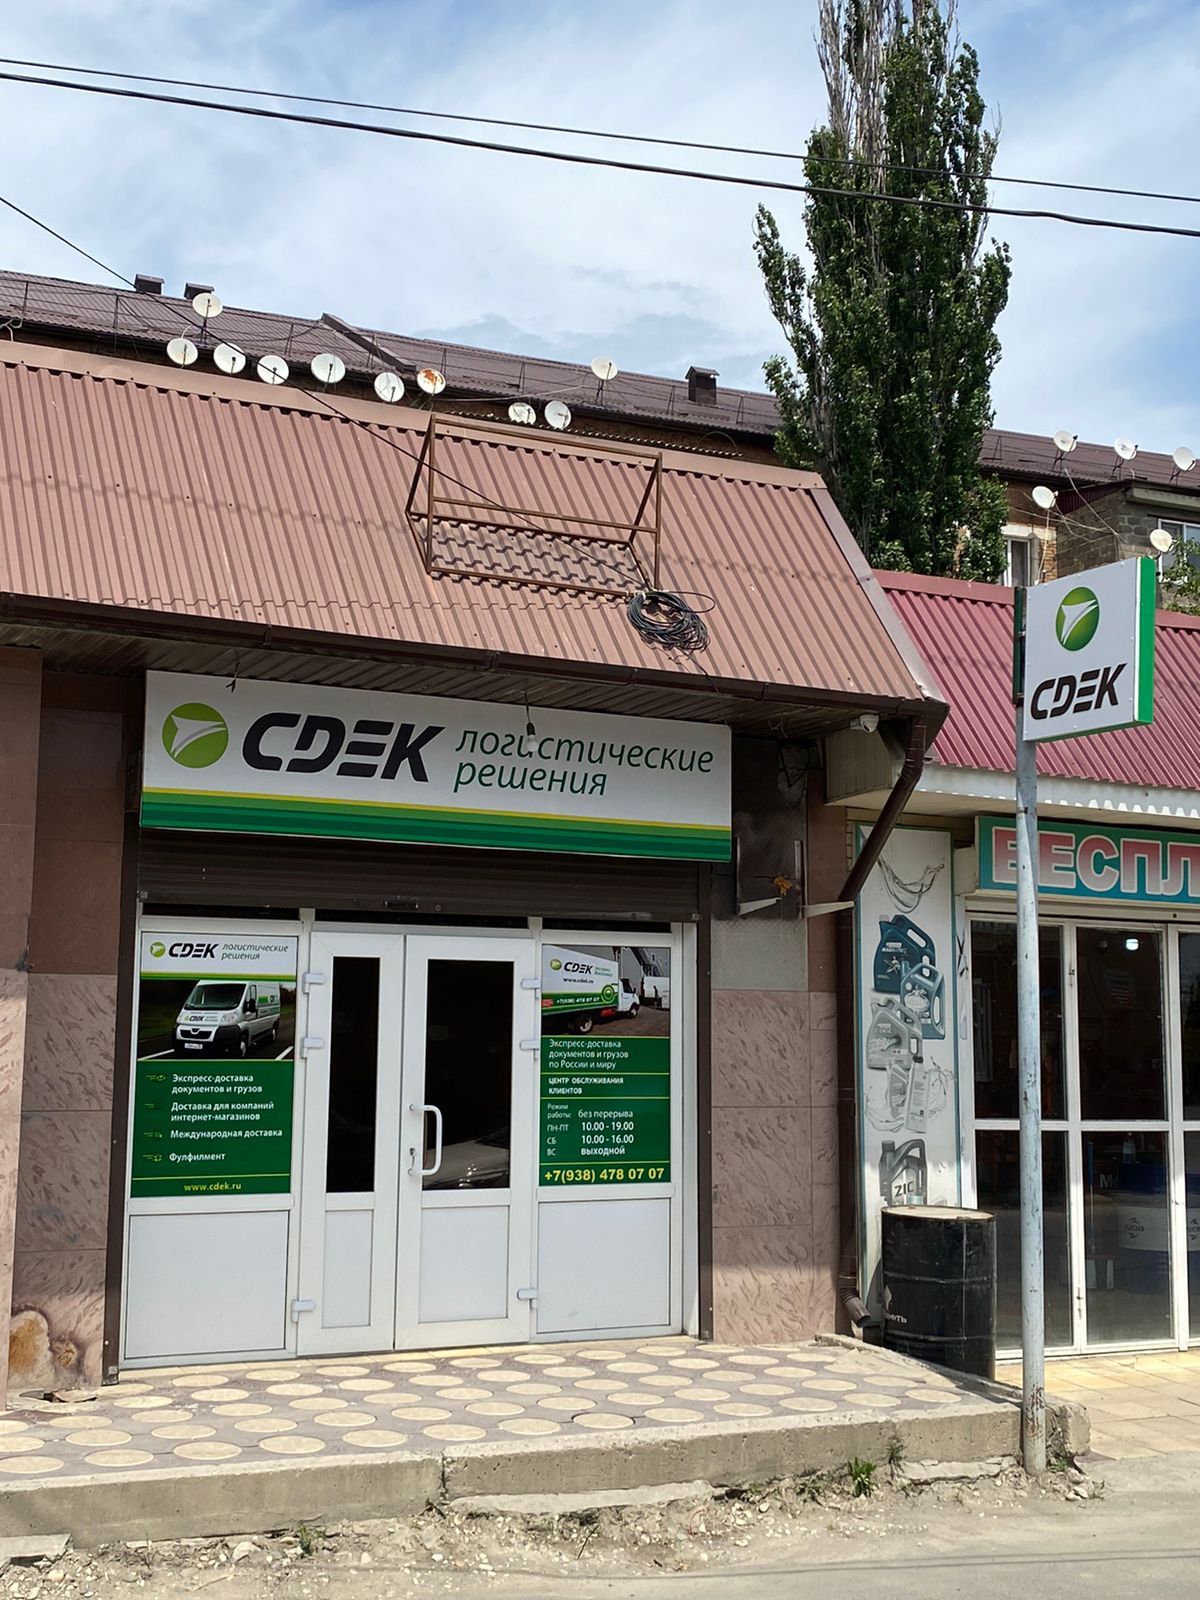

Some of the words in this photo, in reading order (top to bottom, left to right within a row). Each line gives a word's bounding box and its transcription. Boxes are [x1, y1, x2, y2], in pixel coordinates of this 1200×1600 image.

[1030, 662, 1128, 720] CDEK
[242, 712, 446, 783] CDEK
[455, 729, 714, 773] логистические
[454, 757, 608, 796] решения
[168, 943, 219, 958] CDEK
[222, 943, 288, 952] логистические
[221, 952, 260, 961] решения
[564, 962, 594, 974] CDEK
[549, 1039, 622, 1048] Экспресс-доставка
[549, 1051, 595, 1059] документов
[603, 1051, 628, 1059] грузов
[561, 1060, 588, 1068] России
[596, 1062, 616, 1070] миру
[172, 1074, 254, 1083] Экспресс-доставка
[172, 1086, 224, 1095] документов
[234, 1086, 262, 1094] грузов
[171, 1103, 212, 1111] Доставка
[213, 1103, 229, 1111] для
[231, 1101, 274, 1110] компаний
[171, 1113, 260, 1122] интернет-магазинов
[594, 1111, 633, 1120] перерыва
[582, 1122, 604, 1131] 10.00
[612, 1121, 634, 1130] 19.00
[171, 1130, 242, 1140] Международная
[244, 1130, 282, 1138] доставка
[582, 1135, 604, 1144] 10.00
[612, 1134, 634, 1144] 16.00
[169, 1153, 226, 1162] Фулфилмент
[545, 1170, 595, 1183] +7(938)
[600, 1169, 624, 1180] 478
[628, 1168, 644, 1179] 07
[648, 1168, 664, 1178] 07
[184, 1182, 241, 1191] www.cdek.ru
[895, 1181, 914, 1198] ZIC
